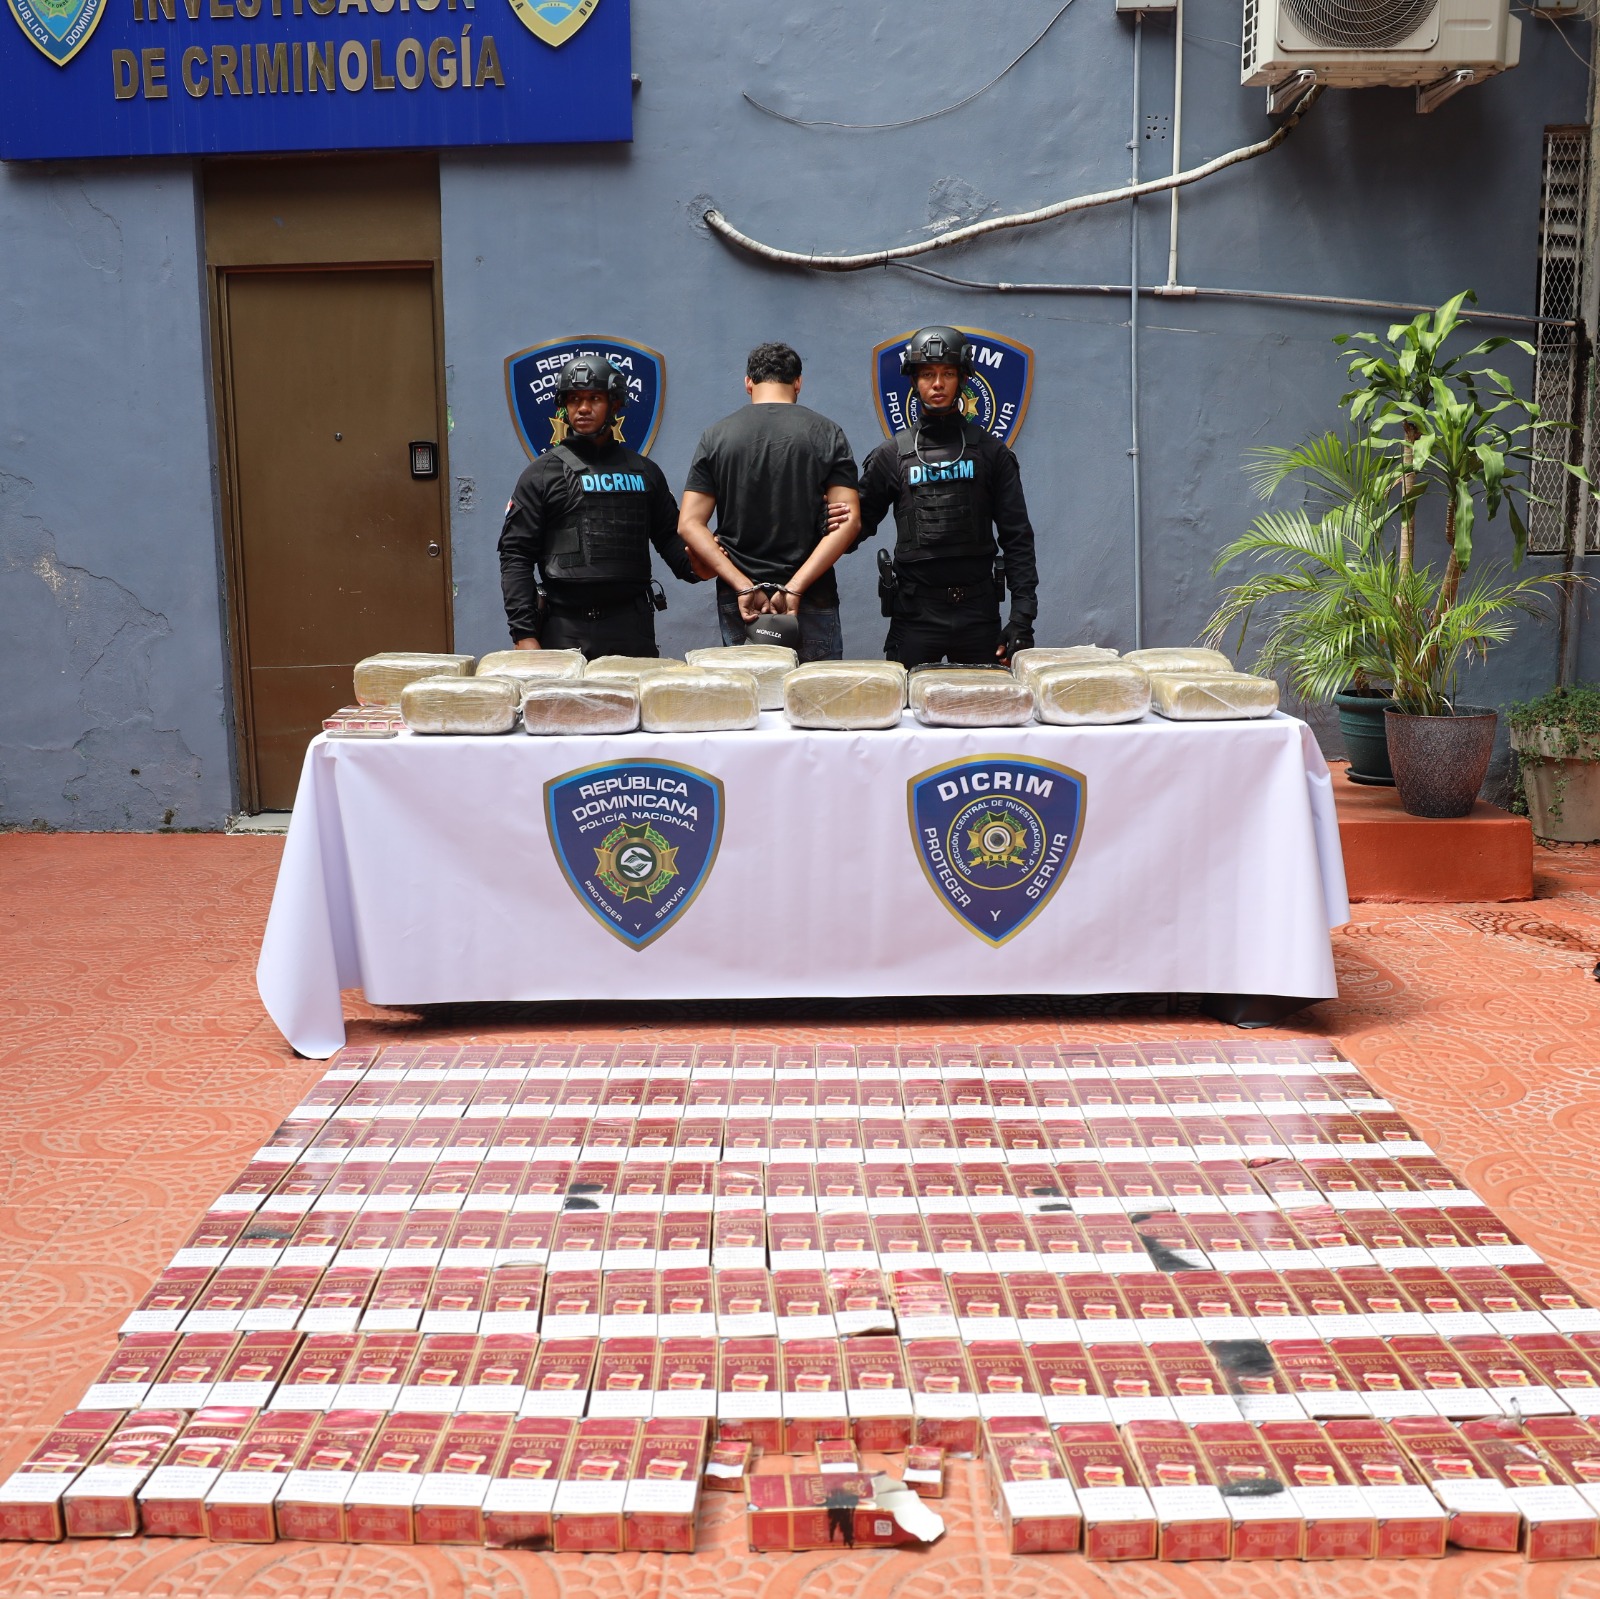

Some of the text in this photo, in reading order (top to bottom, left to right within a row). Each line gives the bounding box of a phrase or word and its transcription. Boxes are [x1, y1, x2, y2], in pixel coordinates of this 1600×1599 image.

[111, 23, 506, 99] DE CRIMINOLOGÍA
[581, 472, 646, 492] DICRIM
[909, 459, 974, 485] DICRIM
[578, 773, 689, 800] REPÚBLICA
[936, 771, 1055, 802] DICRIM
[571, 794, 699, 822] DOMINICANA
[955, 801, 989, 831] CENTRAL
[991, 799, 1003, 807] DE
[578, 811, 697, 834] POLICÍA NACIONAL
[950, 831, 972, 877] DIRECCIÓN
[924, 827, 1068, 922] PROTEGER Y SERVIR
[584, 880, 623, 922] PROTEGER
[655, 886, 686, 919] SERVIR
